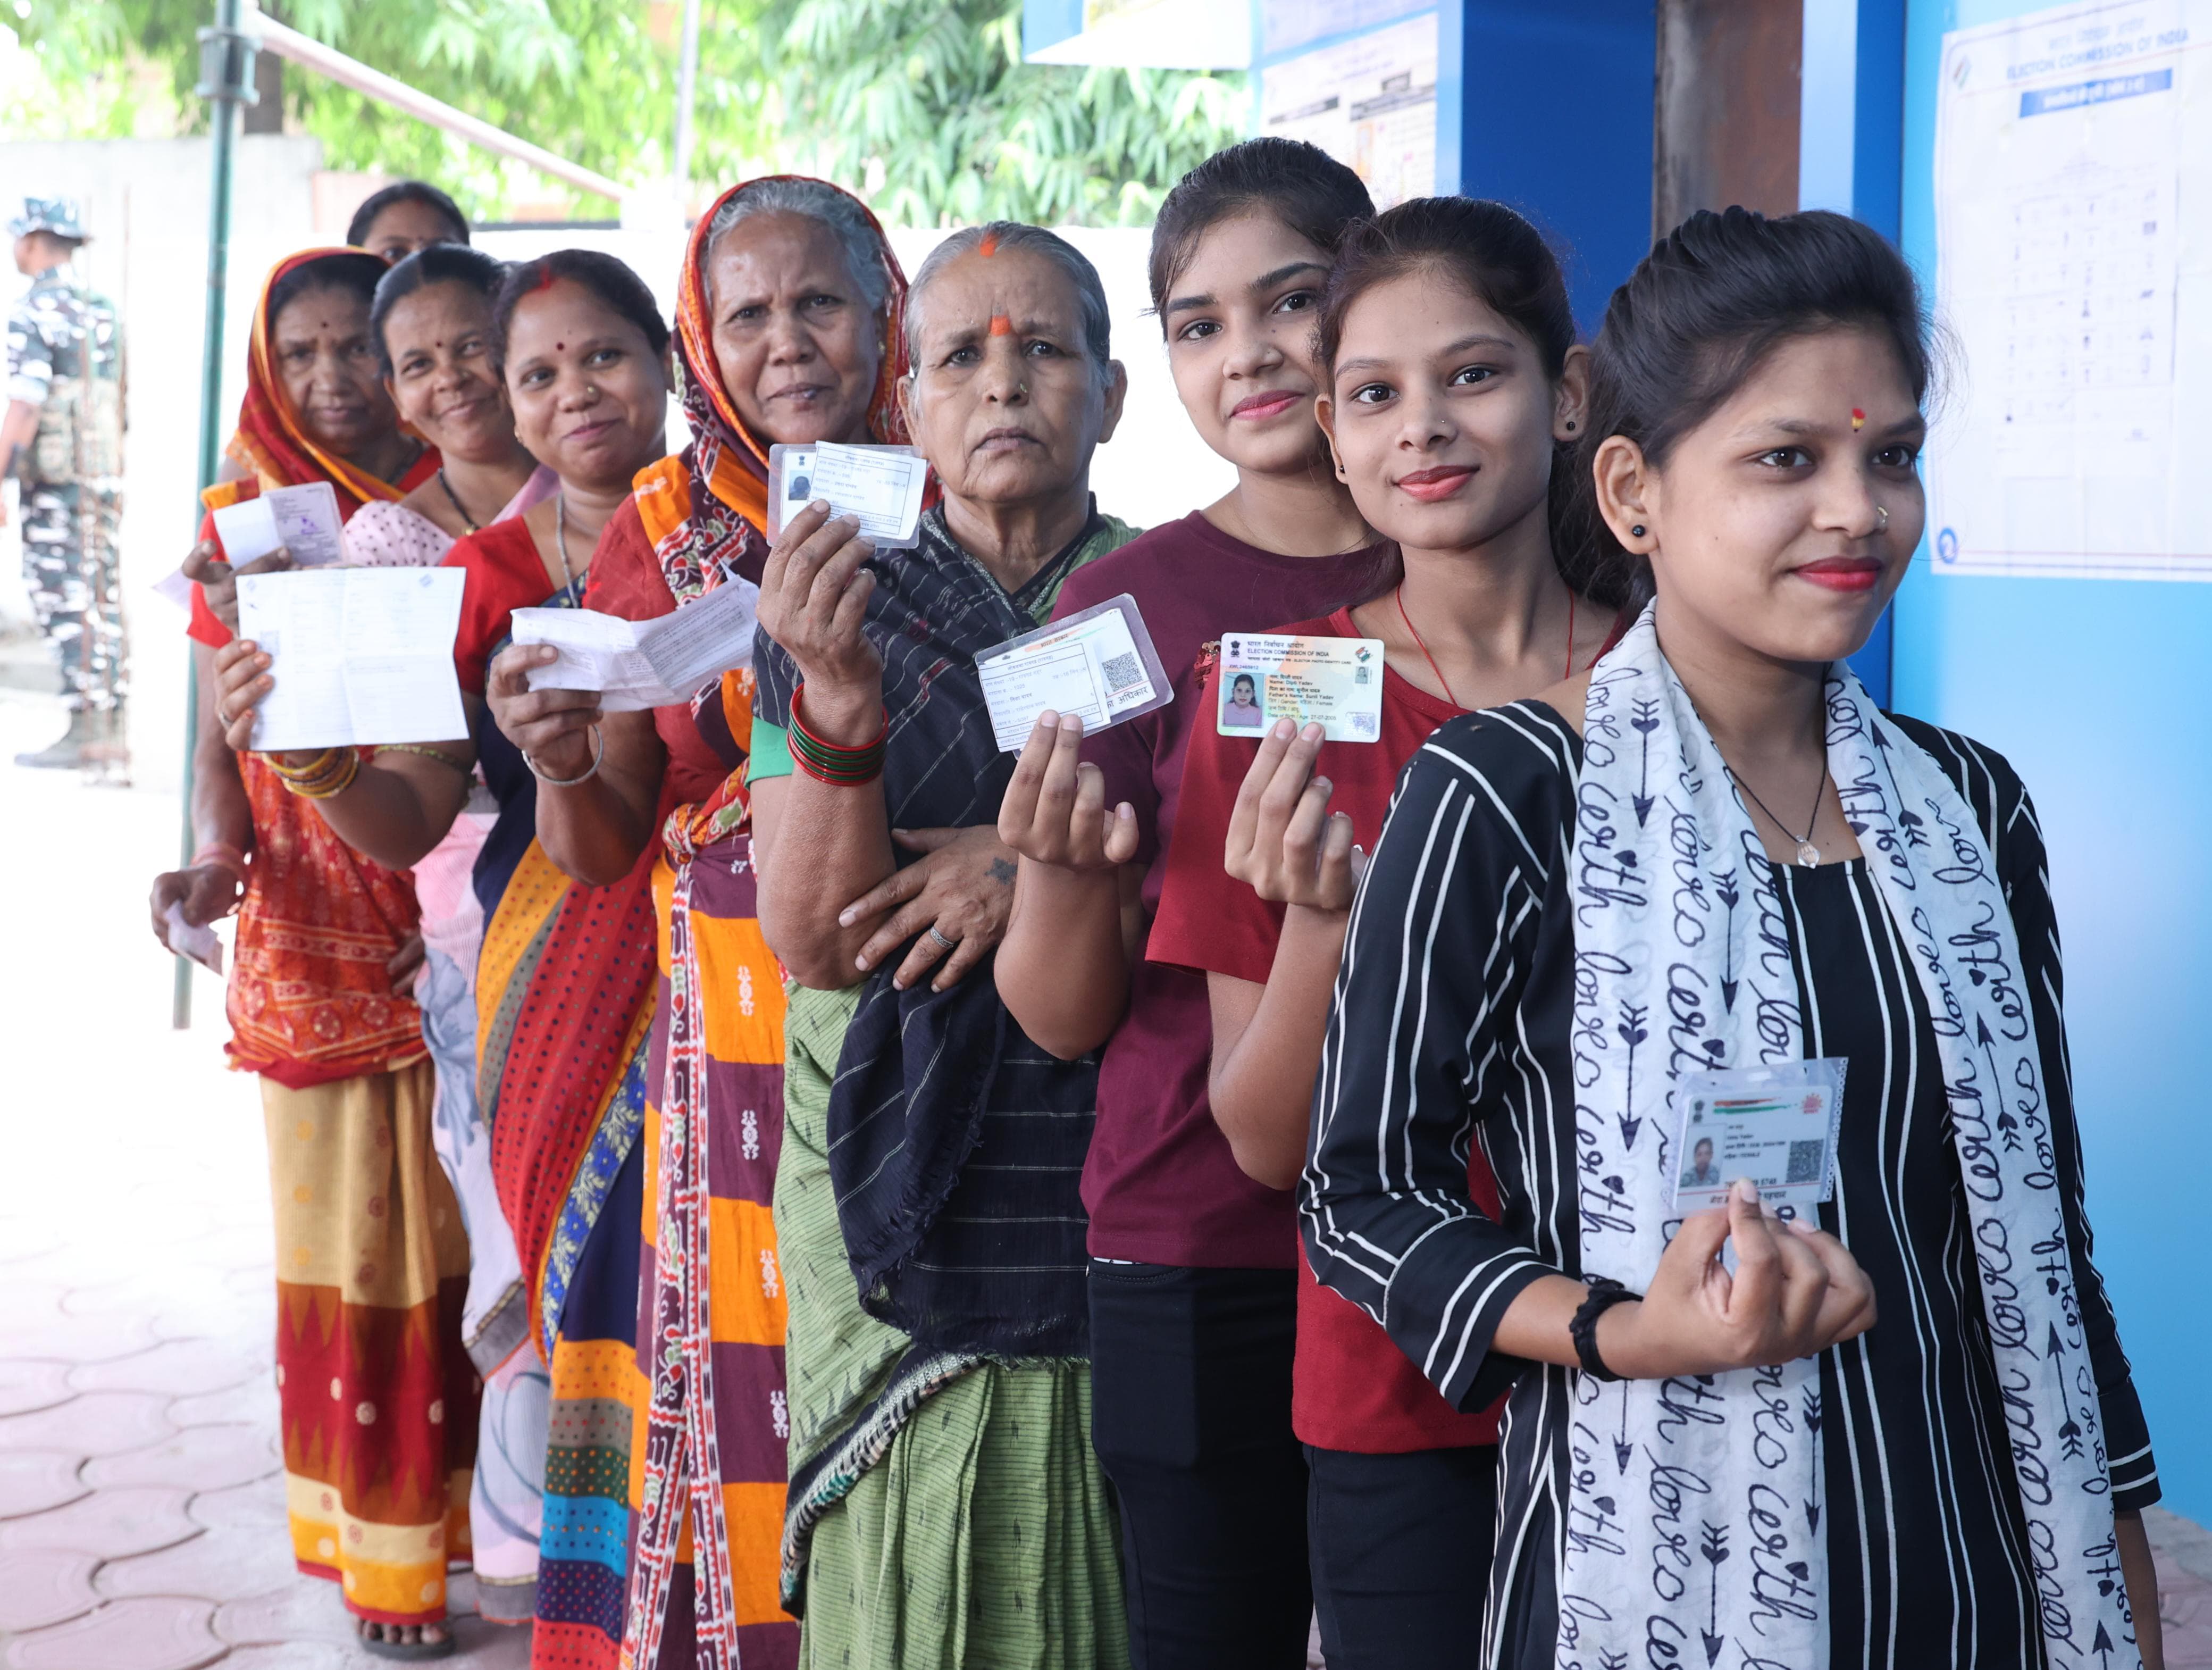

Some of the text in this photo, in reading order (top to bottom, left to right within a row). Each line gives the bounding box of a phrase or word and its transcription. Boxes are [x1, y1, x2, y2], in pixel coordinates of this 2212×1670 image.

[2058, 42, 2133, 70] COMMISSION
[2138, 36, 2152, 52] OF
[2156, 28, 2189, 47] INDIA
[1118, 686, 1149, 704] अधिकार
